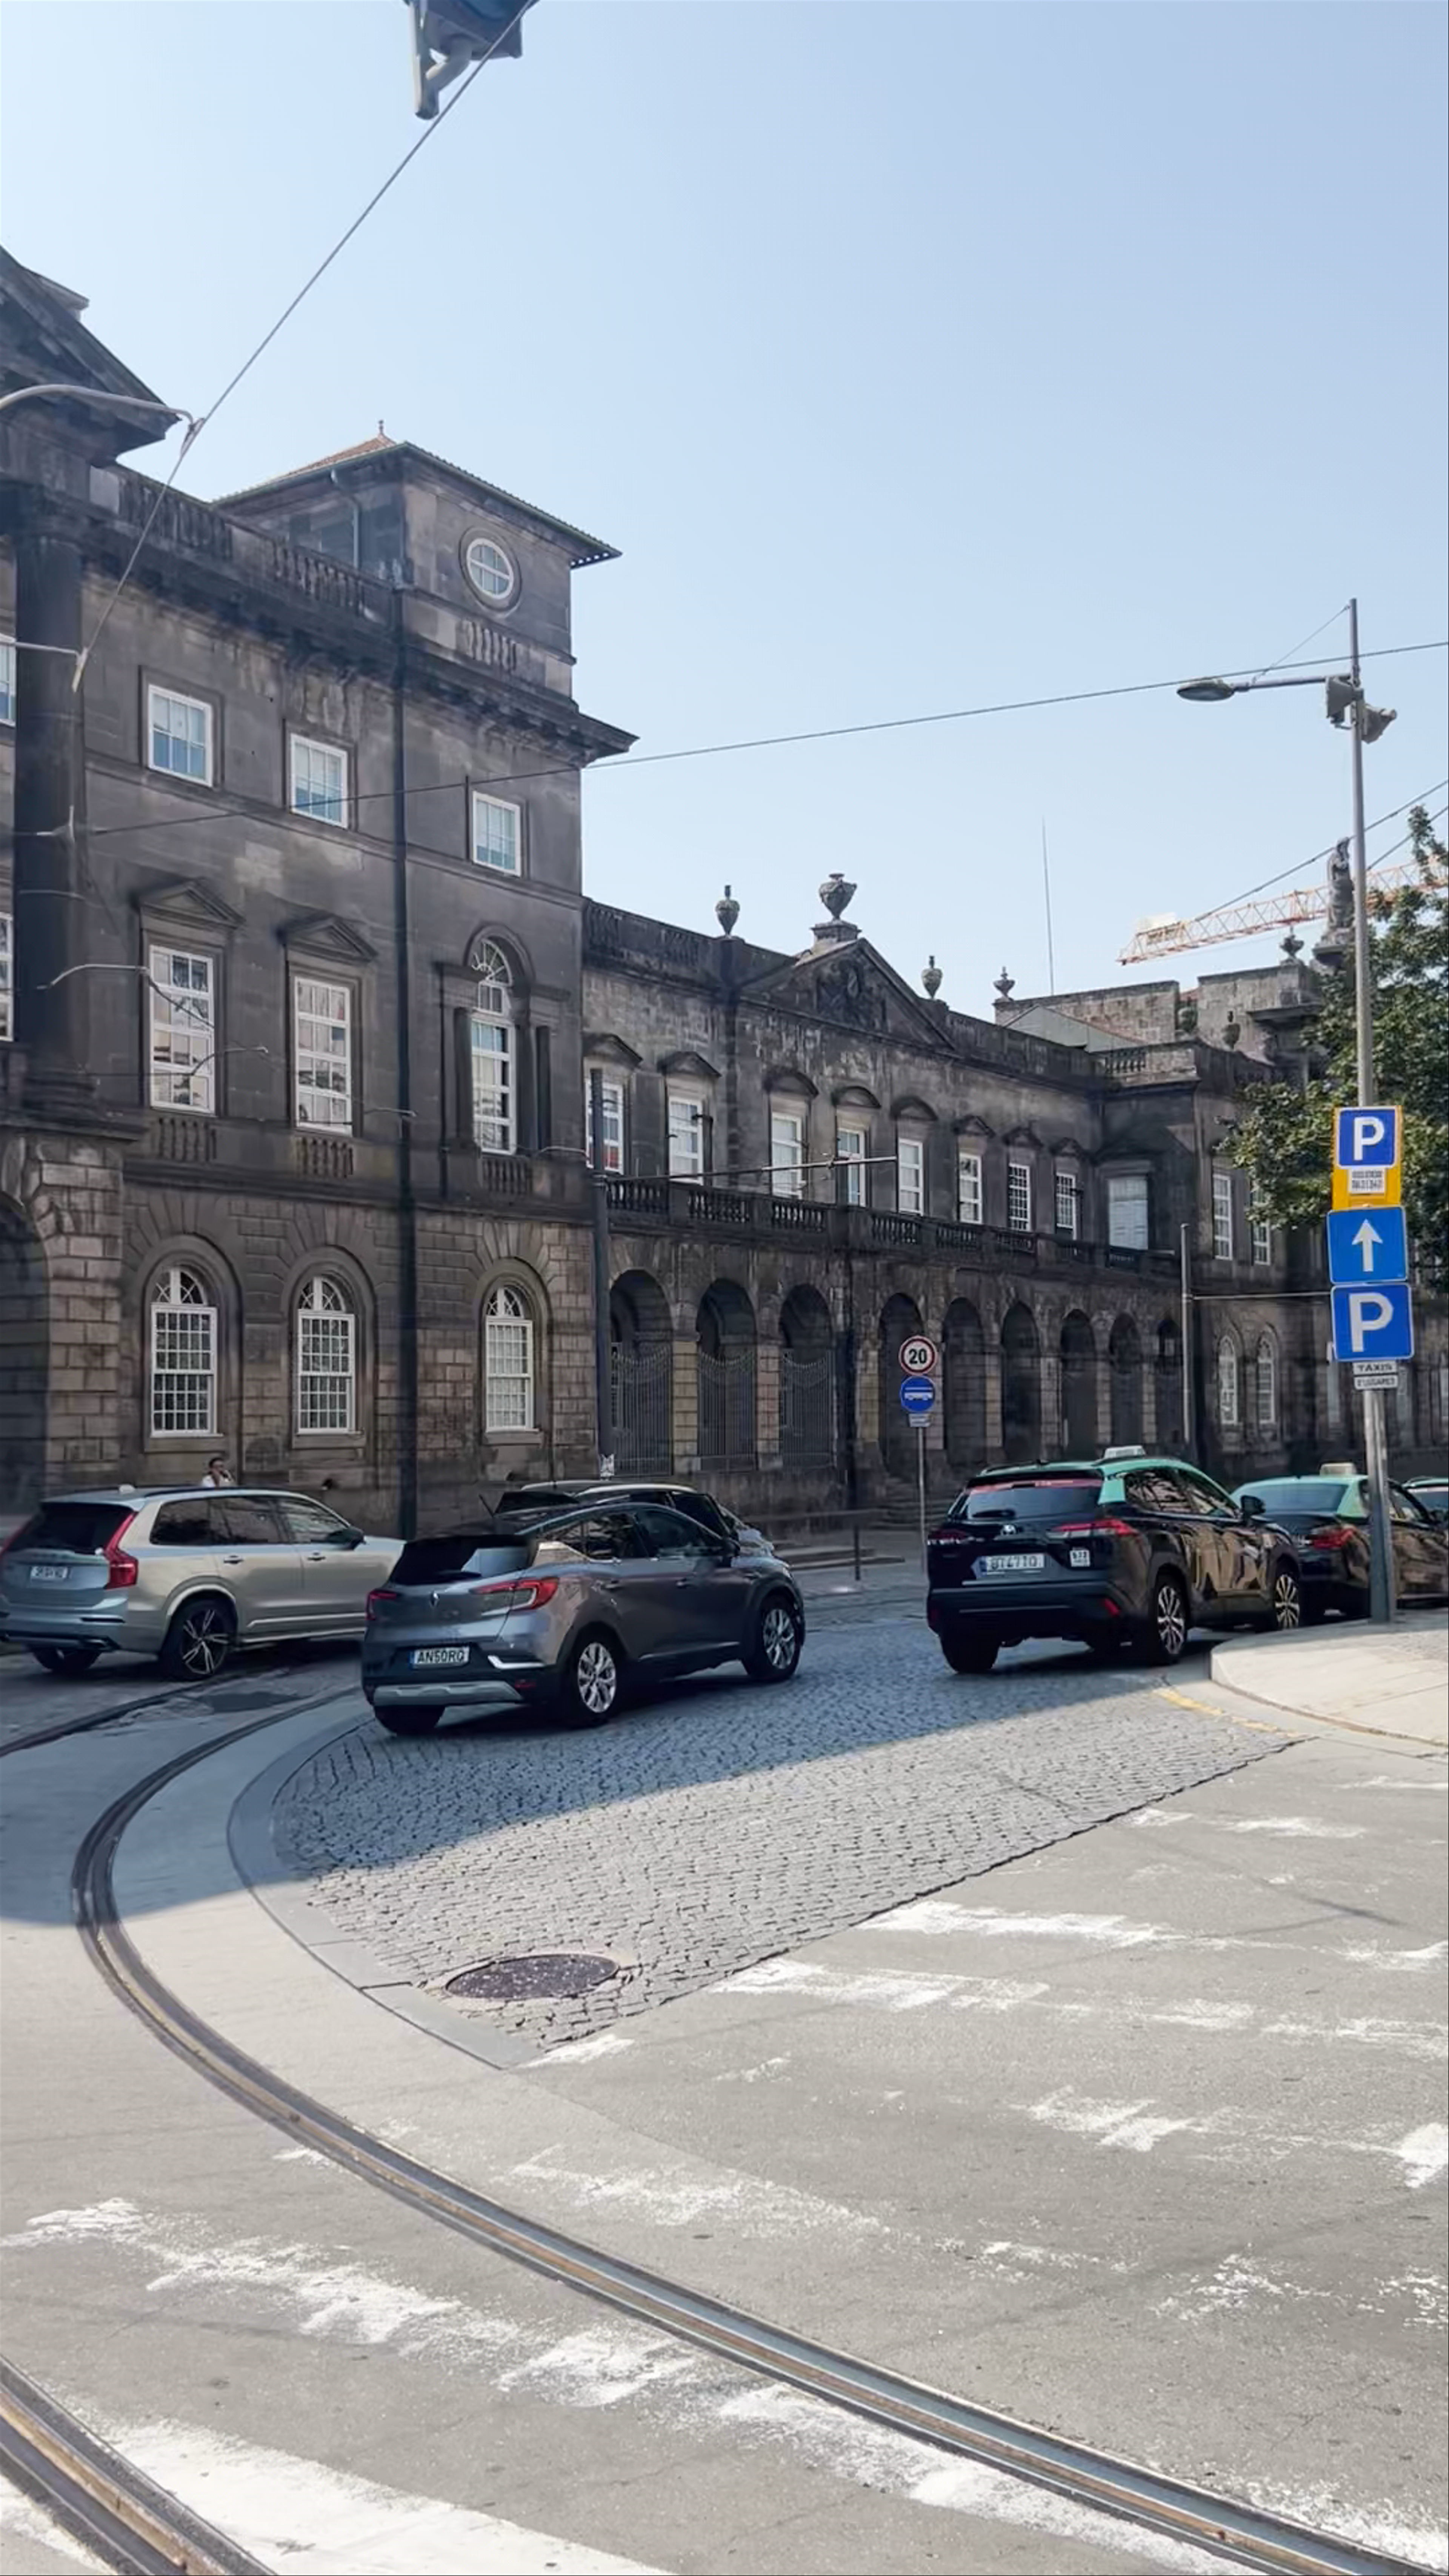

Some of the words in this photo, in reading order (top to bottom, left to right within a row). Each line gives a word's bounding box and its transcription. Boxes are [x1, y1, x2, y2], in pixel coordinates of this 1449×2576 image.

[1353, 1116, 1385, 1161] P
[1349, 1292, 1394, 1352] P
[909, 1349, 928, 1364] 20
